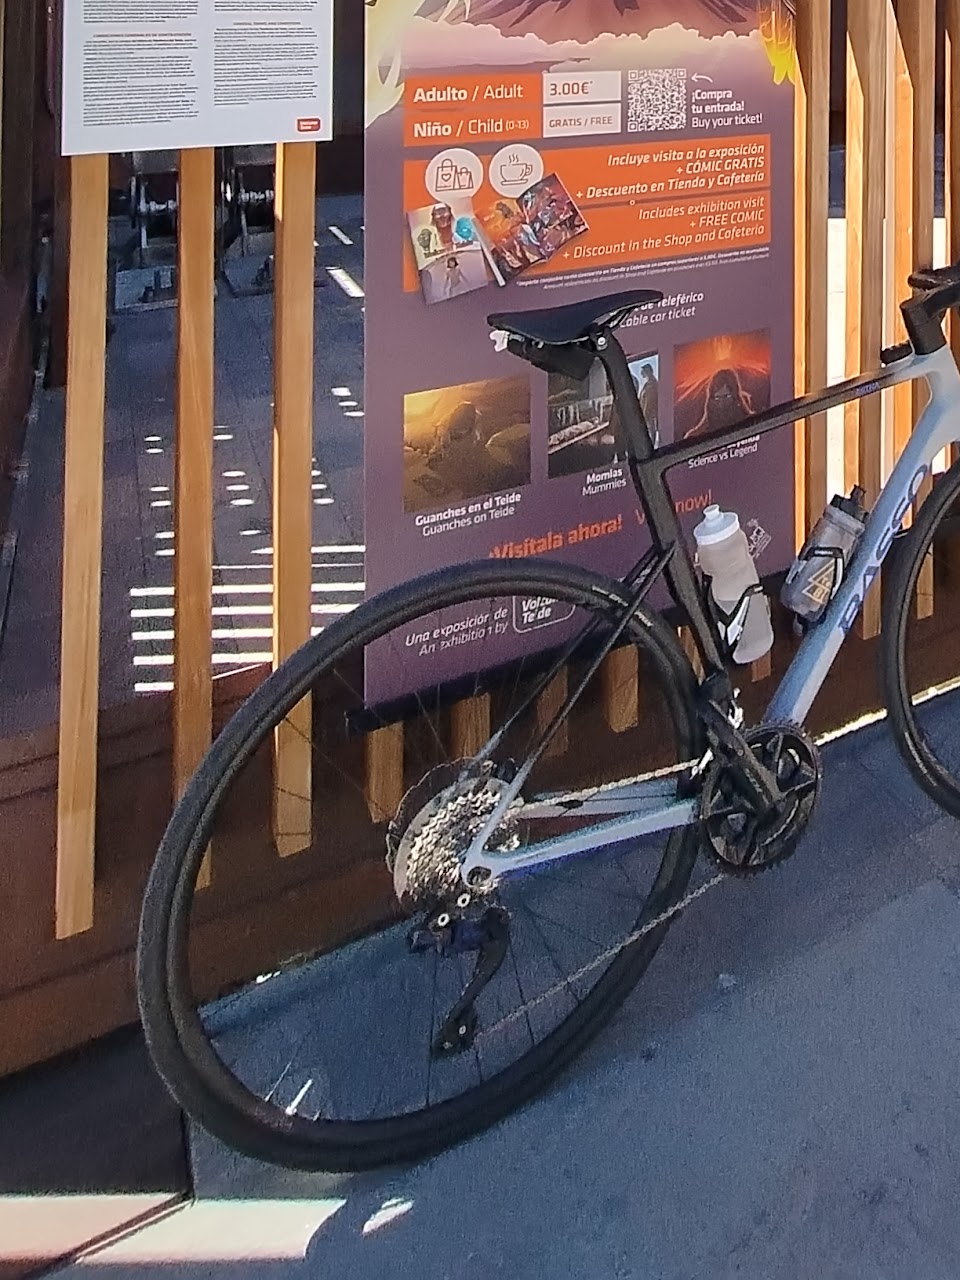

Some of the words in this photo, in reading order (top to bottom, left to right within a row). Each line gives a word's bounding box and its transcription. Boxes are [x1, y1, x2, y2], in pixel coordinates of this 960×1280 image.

[413, 87, 468, 103] Adulto
[483, 84, 523, 100] Adult
[691, 89, 733, 102] ¡Compra
[692, 103, 703, 114] tu
[705, 101, 745, 113] entrada!
[414, 122, 452, 138] Niño
[468, 118, 503, 134] Child
[505, 119, 530, 131] (0-13)
[549, 118, 582, 128] GRATIS
[590, 116, 613, 126] FREE
[692, 117, 710, 129] Buy
[712, 117, 733, 129] your
[734, 113, 763, 126] ticket!
[608, 154, 650, 167] Incluye
[652, 150, 684, 162] visita
[686, 151, 693, 160] a
[695, 148, 706, 159] la
[708, 144, 764, 160] exposición
[724, 156, 764, 171] GRATIS
[586, 184, 648, 199] Descuento
[650, 181, 665, 192] en
[668, 176, 706, 190] Tienda
[707, 177, 715, 189] y
[717, 172, 764, 187] Cafetería
[639, 205, 685, 220] Includes
[687, 199, 741, 216] exhibition
[743, 196, 764, 209] visit
[699, 213, 729, 228] FREE
[730, 209, 764, 225] COMIC
[573, 241, 626, 259] Discount
[628, 238, 639, 251] in
[643, 236, 662, 250] the
[664, 232, 692, 248] Shop
[694, 228, 716, 242] and
[717, 223, 764, 241] Cafeteria
[650, 313, 666, 323] car
[668, 306, 696, 320] ticket
[688, 454, 718, 470] Science
[719, 453, 729, 461] vs
[729, 443, 758, 459] Legend
[586, 468, 623, 484] Momias
[582, 478, 627, 496] Mummies
[415, 506, 467, 526] Guanches
[468, 502, 481, 513] en
[483, 499, 493, 510] el
[494, 492, 522, 507] Teide
[675, 489, 713, 513] now!
[422, 518, 472, 537] Guanches
[473, 513, 487, 524] on
[488, 506, 515, 520] Teide
[567, 514, 622, 544] ahora!
[521, 596, 560, 612] Volca
[405, 632, 430, 647] Una
[494, 607, 509, 620] de
[419, 644, 436, 657] An
[494, 621, 510, 635] by
